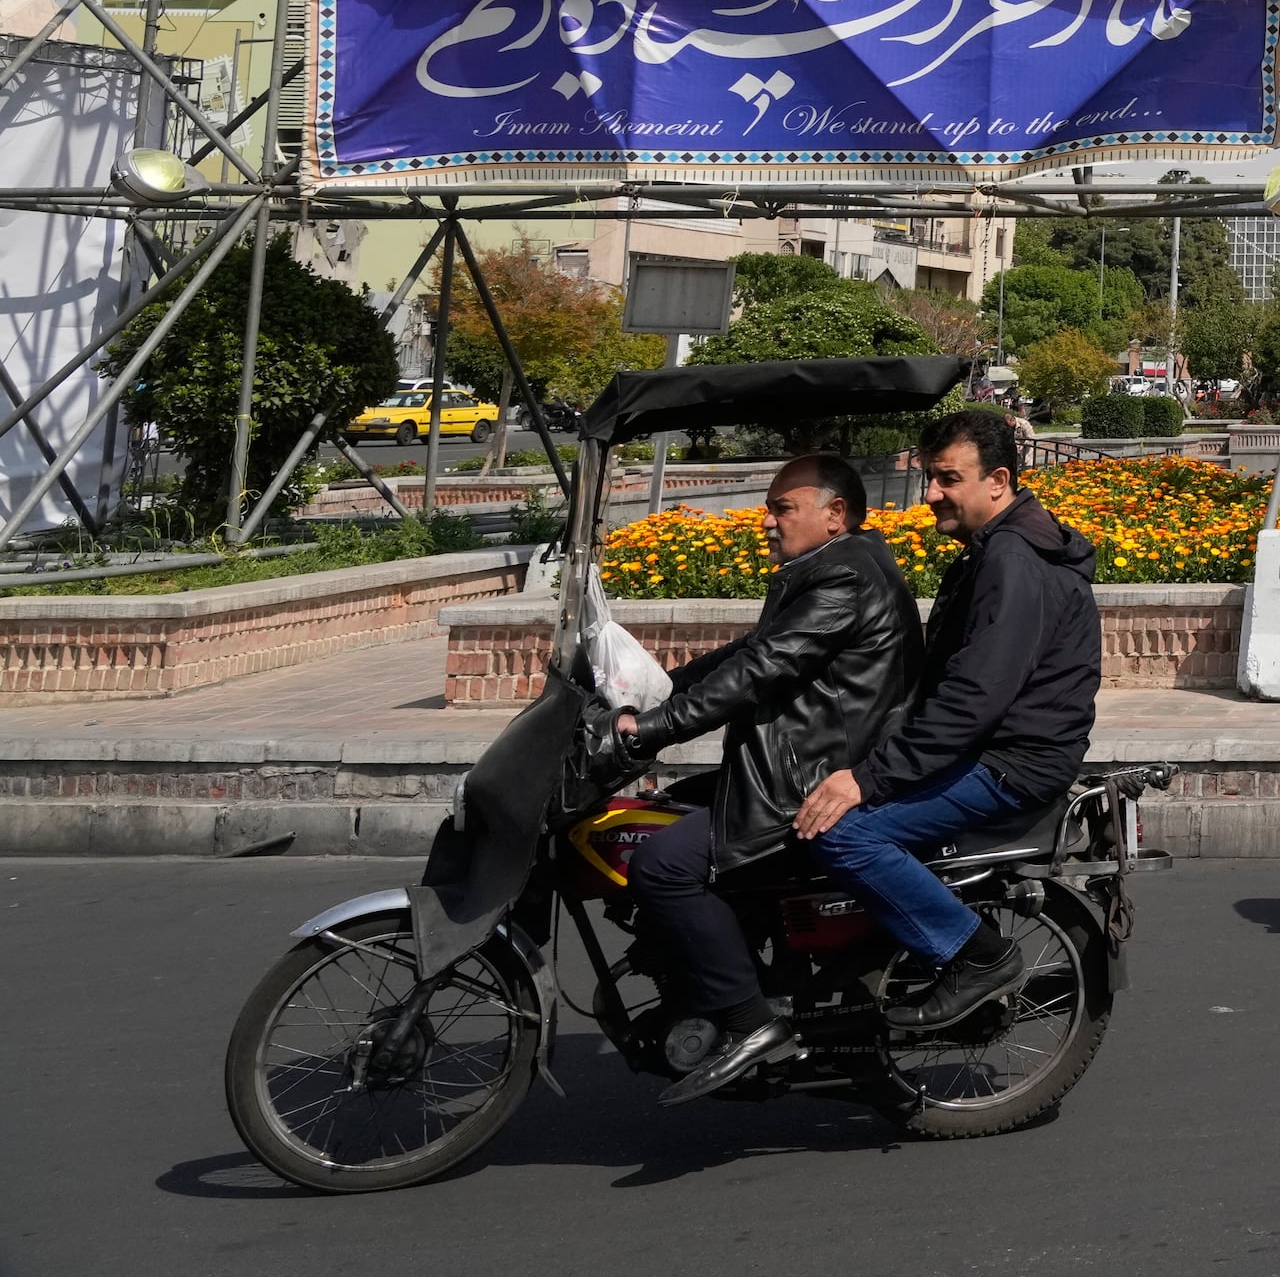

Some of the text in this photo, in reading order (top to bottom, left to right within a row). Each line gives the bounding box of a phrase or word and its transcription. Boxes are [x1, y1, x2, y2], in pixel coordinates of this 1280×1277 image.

[473, 108, 725, 137] Imam Khomeini
[782, 99, 868, 138] We
[987, 111, 1019, 137] to
[1023, 110, 1070, 135] the
[590, 830, 651, 844] HOND
